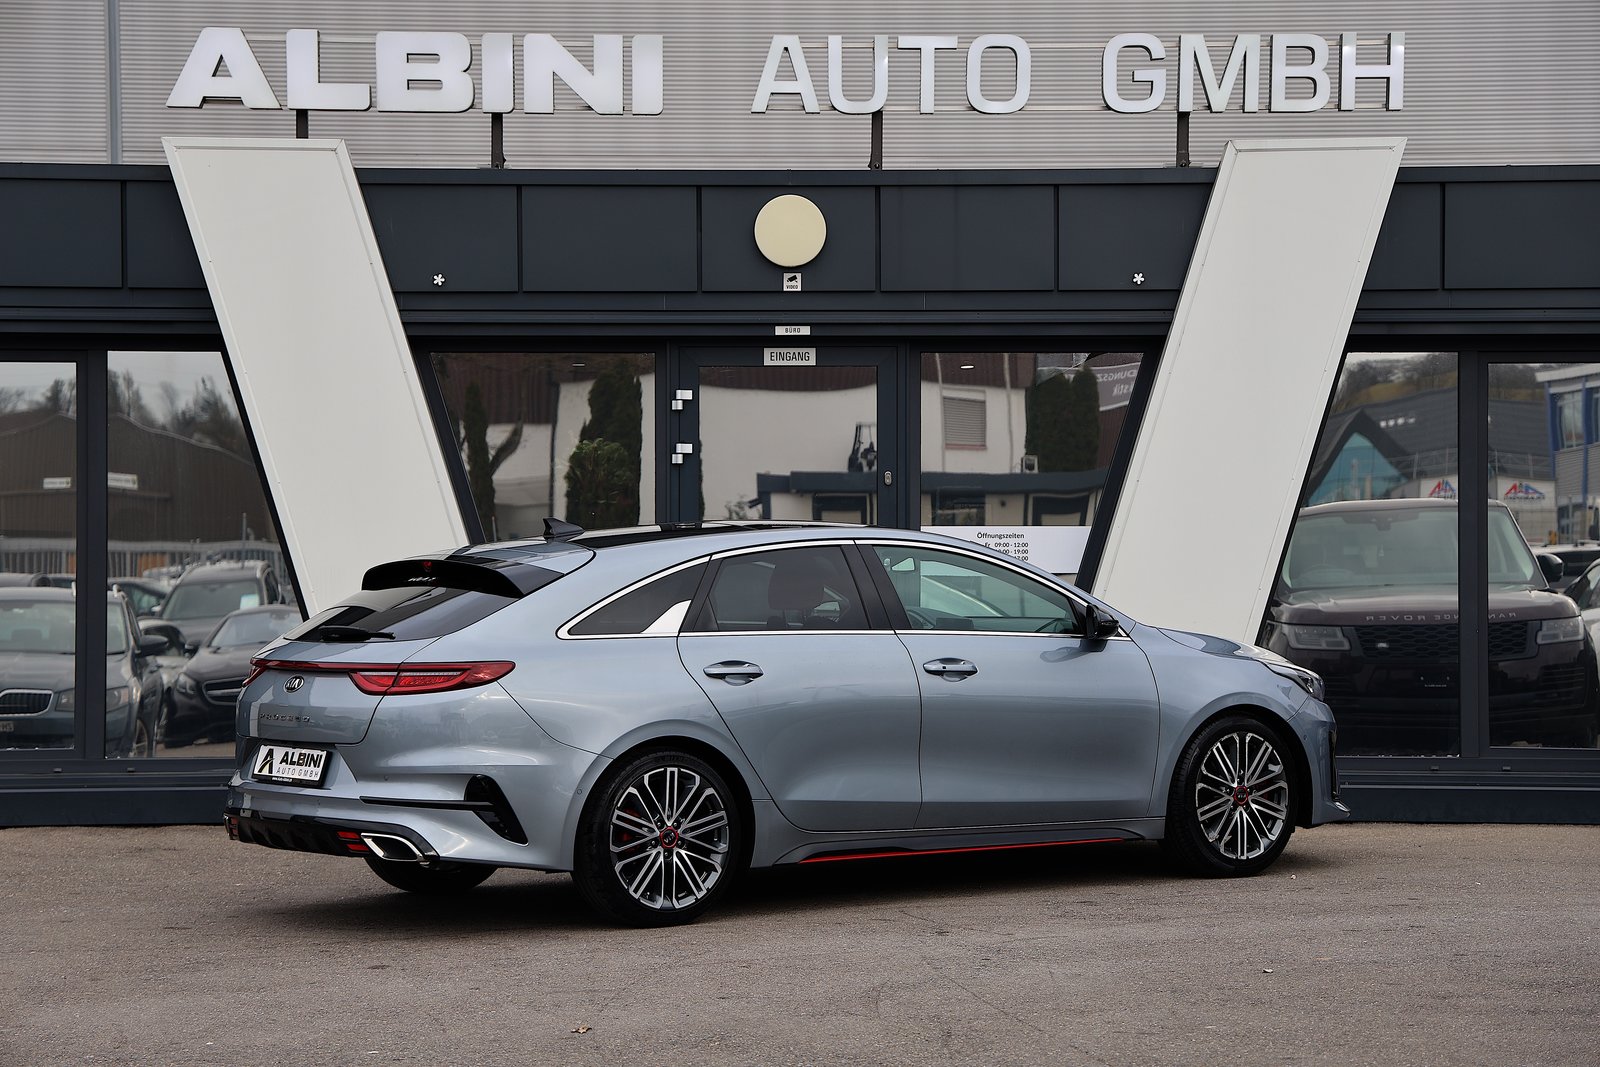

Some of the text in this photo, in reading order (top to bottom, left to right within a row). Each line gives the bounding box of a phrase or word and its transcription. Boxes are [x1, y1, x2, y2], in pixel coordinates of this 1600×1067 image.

[165, 27, 1406, 115] ALBINI AUTO GMBH
[770, 352, 810, 361] EINGANG
[279, 750, 323, 769] ALBINI
[275, 766, 319, 777] AUTO GMBH
